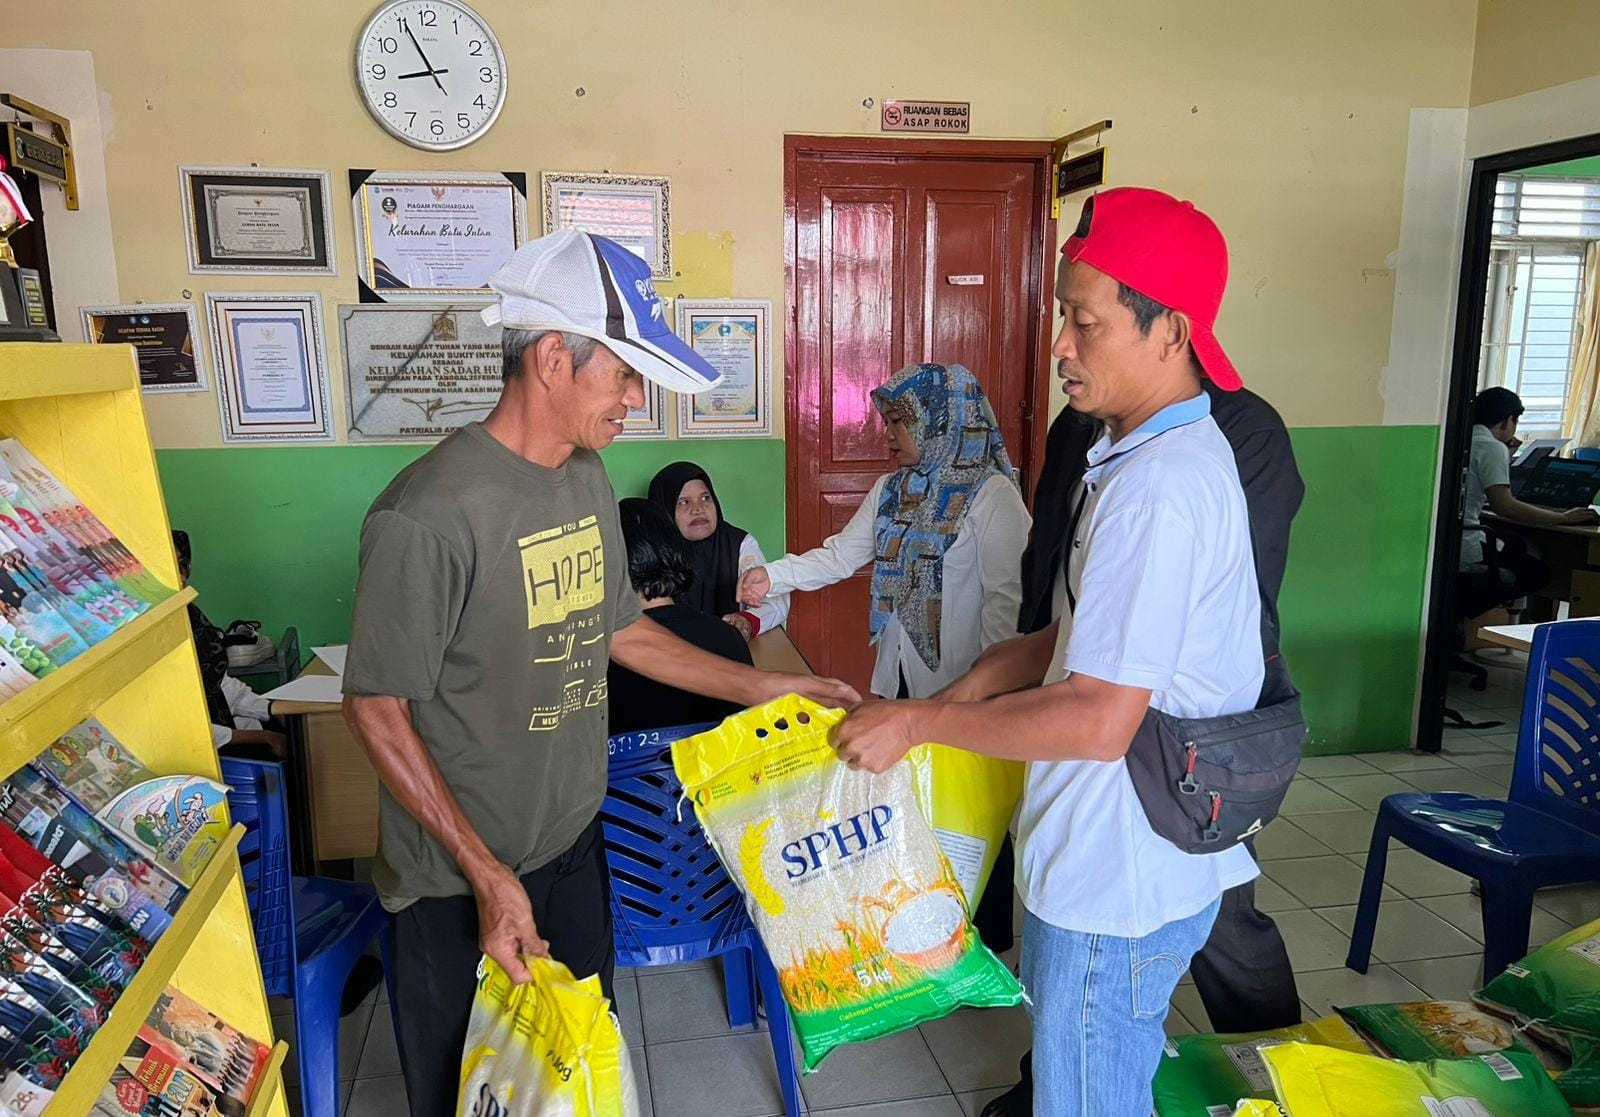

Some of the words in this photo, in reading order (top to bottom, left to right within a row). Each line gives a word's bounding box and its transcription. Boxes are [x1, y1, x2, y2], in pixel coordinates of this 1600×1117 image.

[397, 17, 409, 34] 11
[418, 10, 437, 27] 12
[452, 19, 458, 35] 1
[378, 37, 398, 54] 10
[469, 40, 483, 56] 2
[372, 64, 386, 80] 9
[479, 67, 493, 83] 3
[384, 92, 397, 108] 8
[473, 94, 486, 110] 4
[903, 106, 940, 116] RUANGAN
[943, 107, 967, 116] BEBAS
[404, 111, 417, 128] 7
[430, 119, 444, 136] 6
[457, 113, 470, 129] 5
[903, 118, 930, 127] ASAP
[934, 119, 967, 128] ROKOK
[388, 223, 437, 237] Kelurahan
[439, 223, 462, 237] Batu
[464, 223, 492, 237] Intan
[390, 351, 445, 359] KELURAHAN
[447, 351, 474, 359] BUKIT
[476, 351, 503, 359] INTAN
[369, 366, 441, 375] KELURAHAN
[444, 366, 480, 375] SADAR
[484, 366, 503, 375] HU
[563, 522, 577, 532] YOU
[528, 545, 602, 606] HOPE
[638, 731, 660, 747] 23
[781, 804, 893, 880] SPHP
[856, 968, 872, 988] 5
[872, 968, 893, 984] kg
